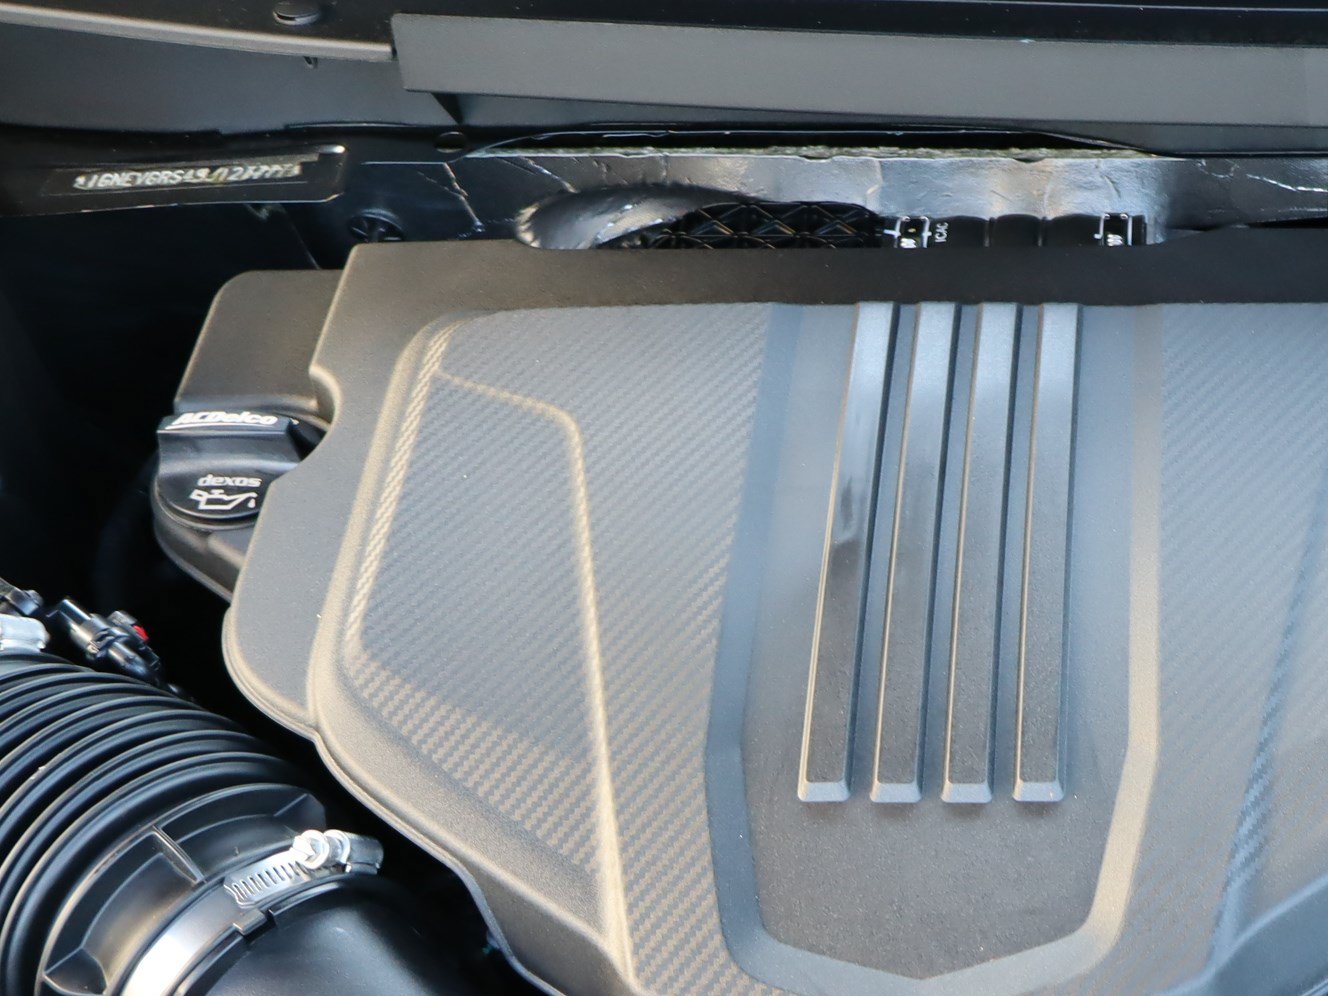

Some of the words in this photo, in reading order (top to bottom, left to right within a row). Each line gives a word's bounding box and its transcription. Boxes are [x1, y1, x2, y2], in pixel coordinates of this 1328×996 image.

[934, 222, 949, 243] ICAC
[171, 410, 279, 429] ACDelco
[197, 473, 262, 488] dexos
